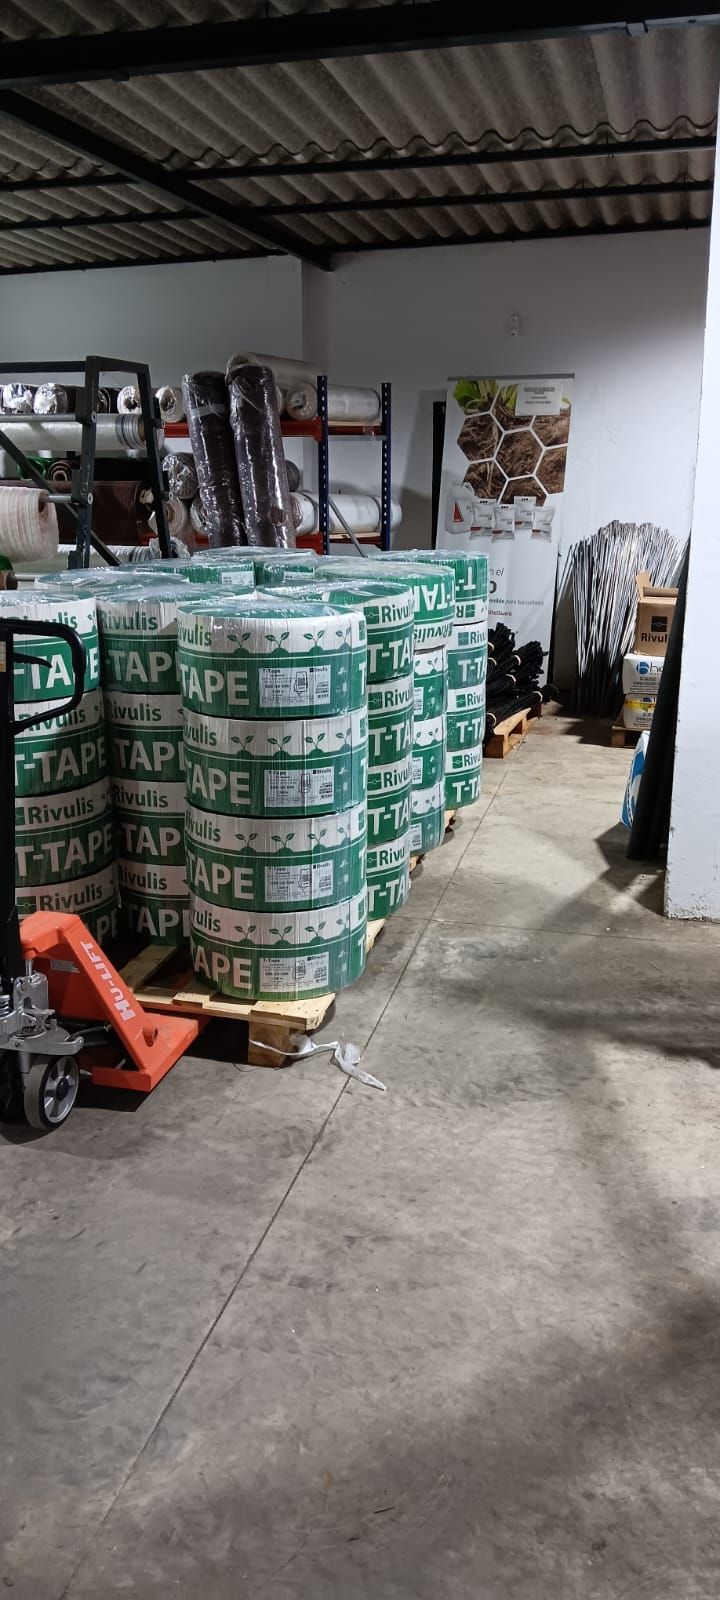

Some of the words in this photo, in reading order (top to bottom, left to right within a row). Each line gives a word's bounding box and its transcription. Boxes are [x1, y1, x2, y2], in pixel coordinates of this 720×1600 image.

[101, 610, 158, 631] Rivulis
[28, 798, 95, 825] Rivulis
[15, 823, 113, 877] T-TAPE
[40, 884, 103, 912] Rivulis
[80, 940, 136, 1022] HU-LIFT
